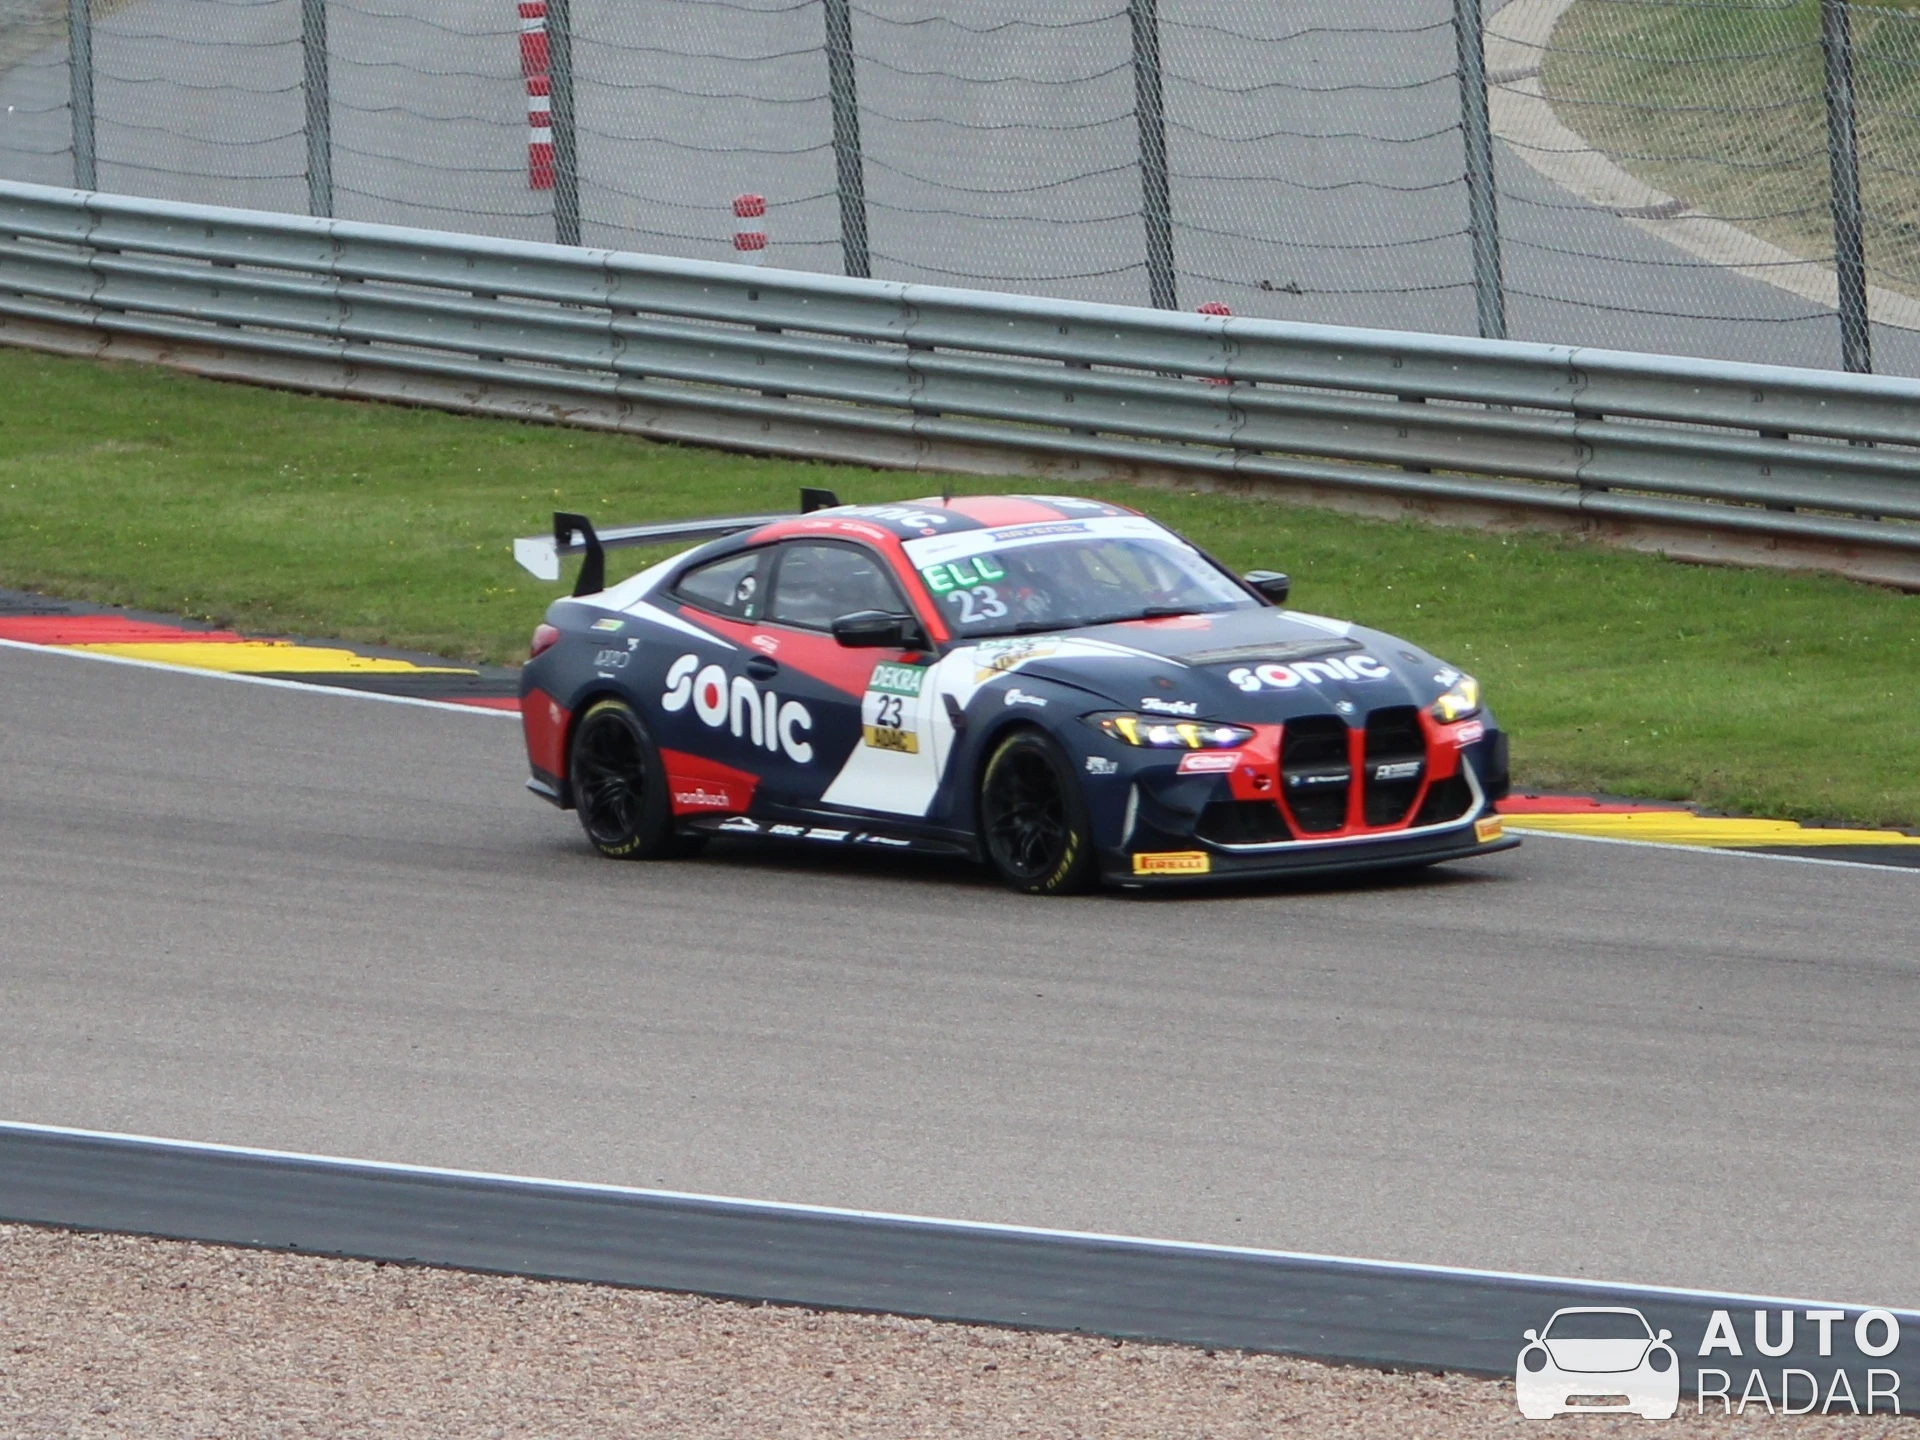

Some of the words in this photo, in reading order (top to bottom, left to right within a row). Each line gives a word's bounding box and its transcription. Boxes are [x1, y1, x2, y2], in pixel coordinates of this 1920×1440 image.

[922, 556, 1004, 594] ELL
[946, 585, 1009, 625] 23
[869, 662, 924, 694] DEKRA
[876, 694, 903, 730] 23
[873, 727, 909, 752] ADAC
[1140, 853, 1202, 870] PIRELLI
